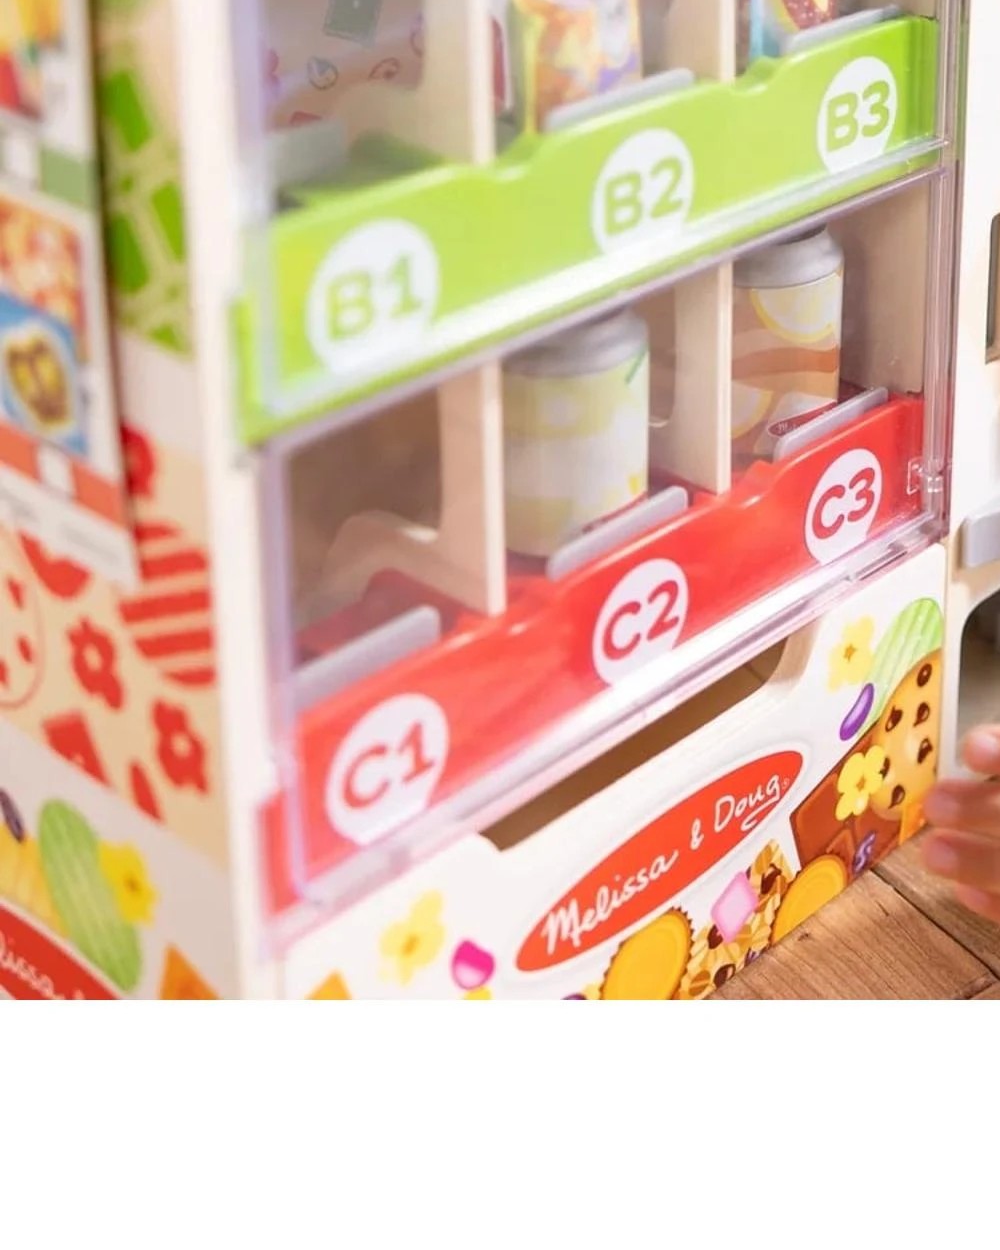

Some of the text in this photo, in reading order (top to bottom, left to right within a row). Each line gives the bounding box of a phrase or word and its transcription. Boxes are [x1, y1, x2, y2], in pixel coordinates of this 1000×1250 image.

[825, 79, 891, 150] B3
[603, 157, 684, 233] B2
[326, 256, 422, 341] B1
[811, 467, 876, 538] C3
[602, 579, 680, 662] C2
[342, 723, 435, 811] C1
[541, 850, 680, 955] Melissa
